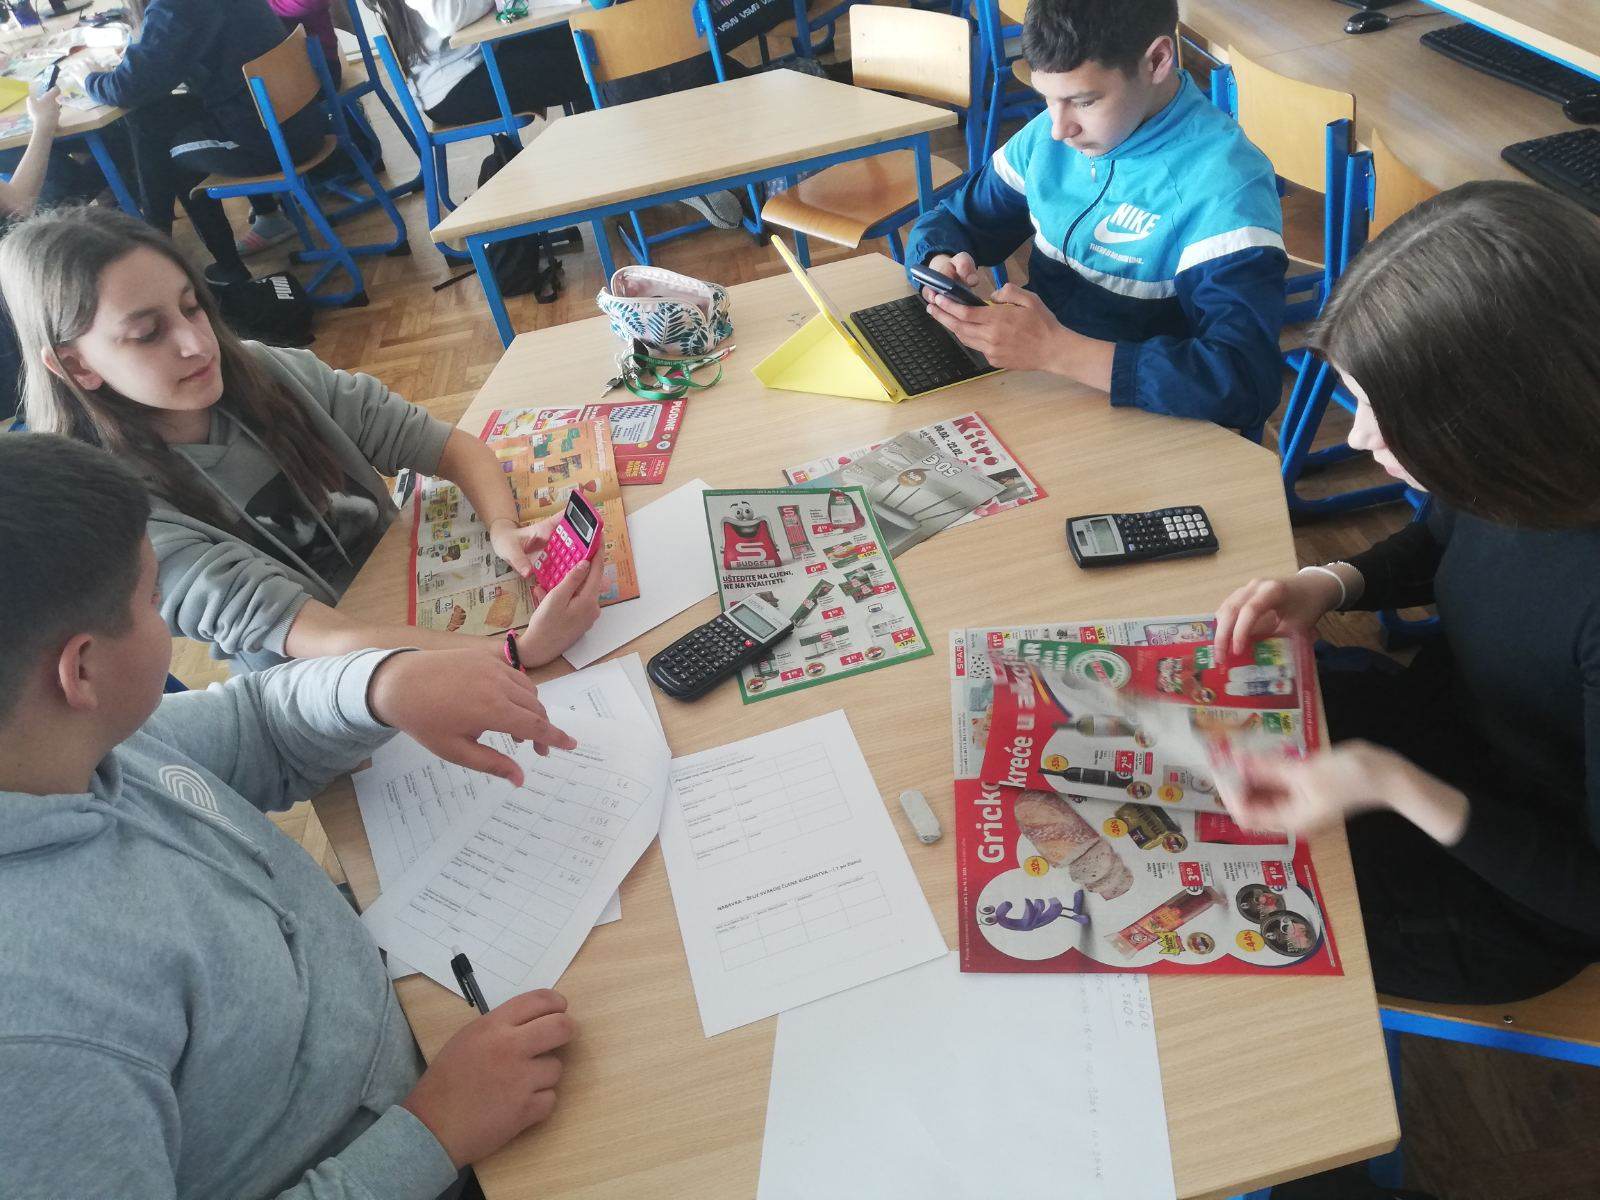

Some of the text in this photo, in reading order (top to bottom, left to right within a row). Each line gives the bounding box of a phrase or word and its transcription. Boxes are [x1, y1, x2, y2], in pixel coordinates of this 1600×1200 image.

[1109, 202, 1161, 234] NIKE
[269, 276, 294, 299] PUMA
[664, 401, 683, 432] PLODINE
[951, 415, 1000, 466] Kitro
[723, 574, 757, 583] UŠTEDITE
[998, 736, 1034, 788] kreće
